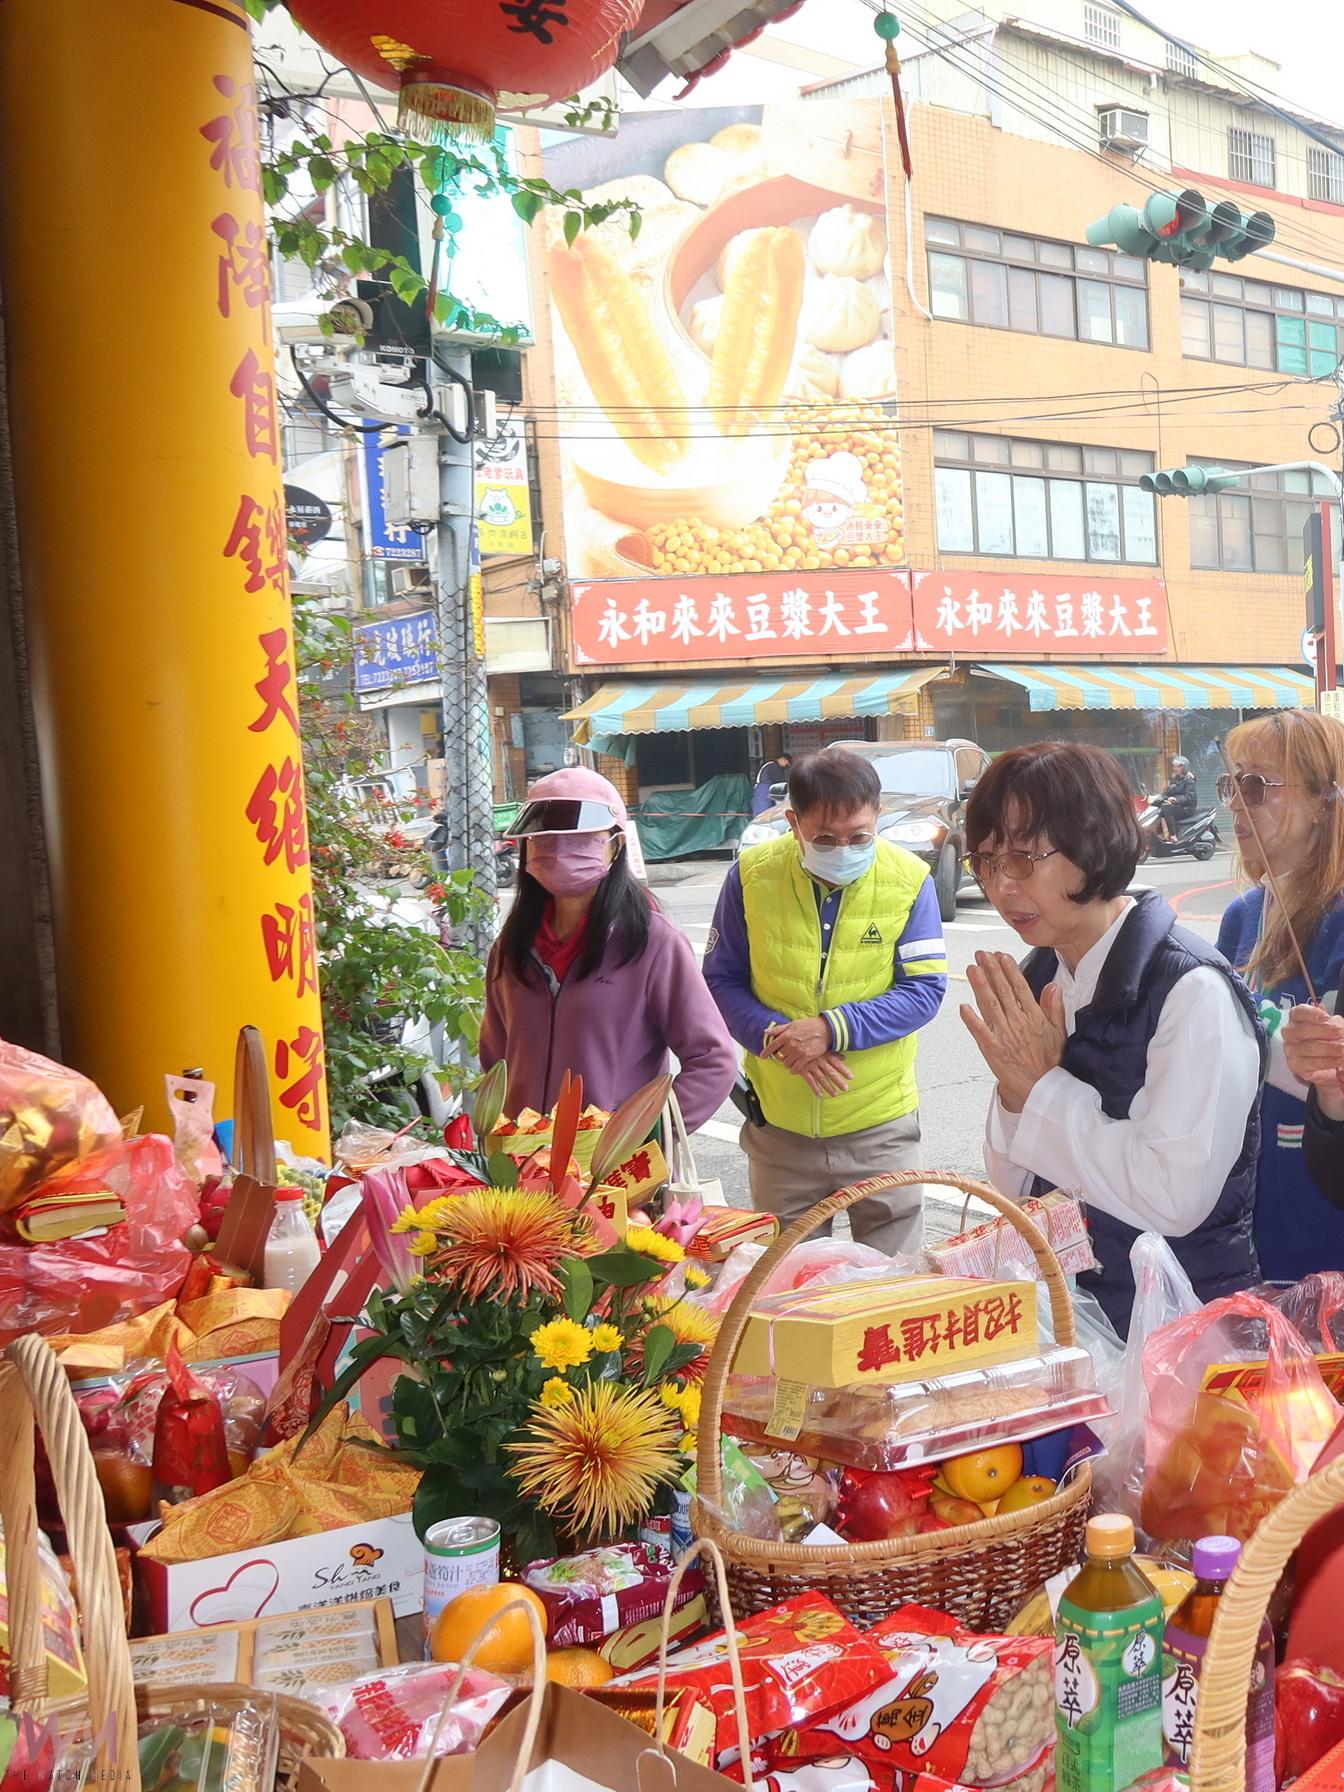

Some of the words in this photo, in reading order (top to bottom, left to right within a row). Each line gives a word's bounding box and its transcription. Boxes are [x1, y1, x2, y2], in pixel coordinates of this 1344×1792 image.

[599, 588, 889, 648] 永和來來豆漿大王
[935, 586, 1158, 638] 永和來來豆漿大王
[857, 1291, 1023, 1372] 招財進寶
[1056, 1633, 1083, 1729] 原萃
